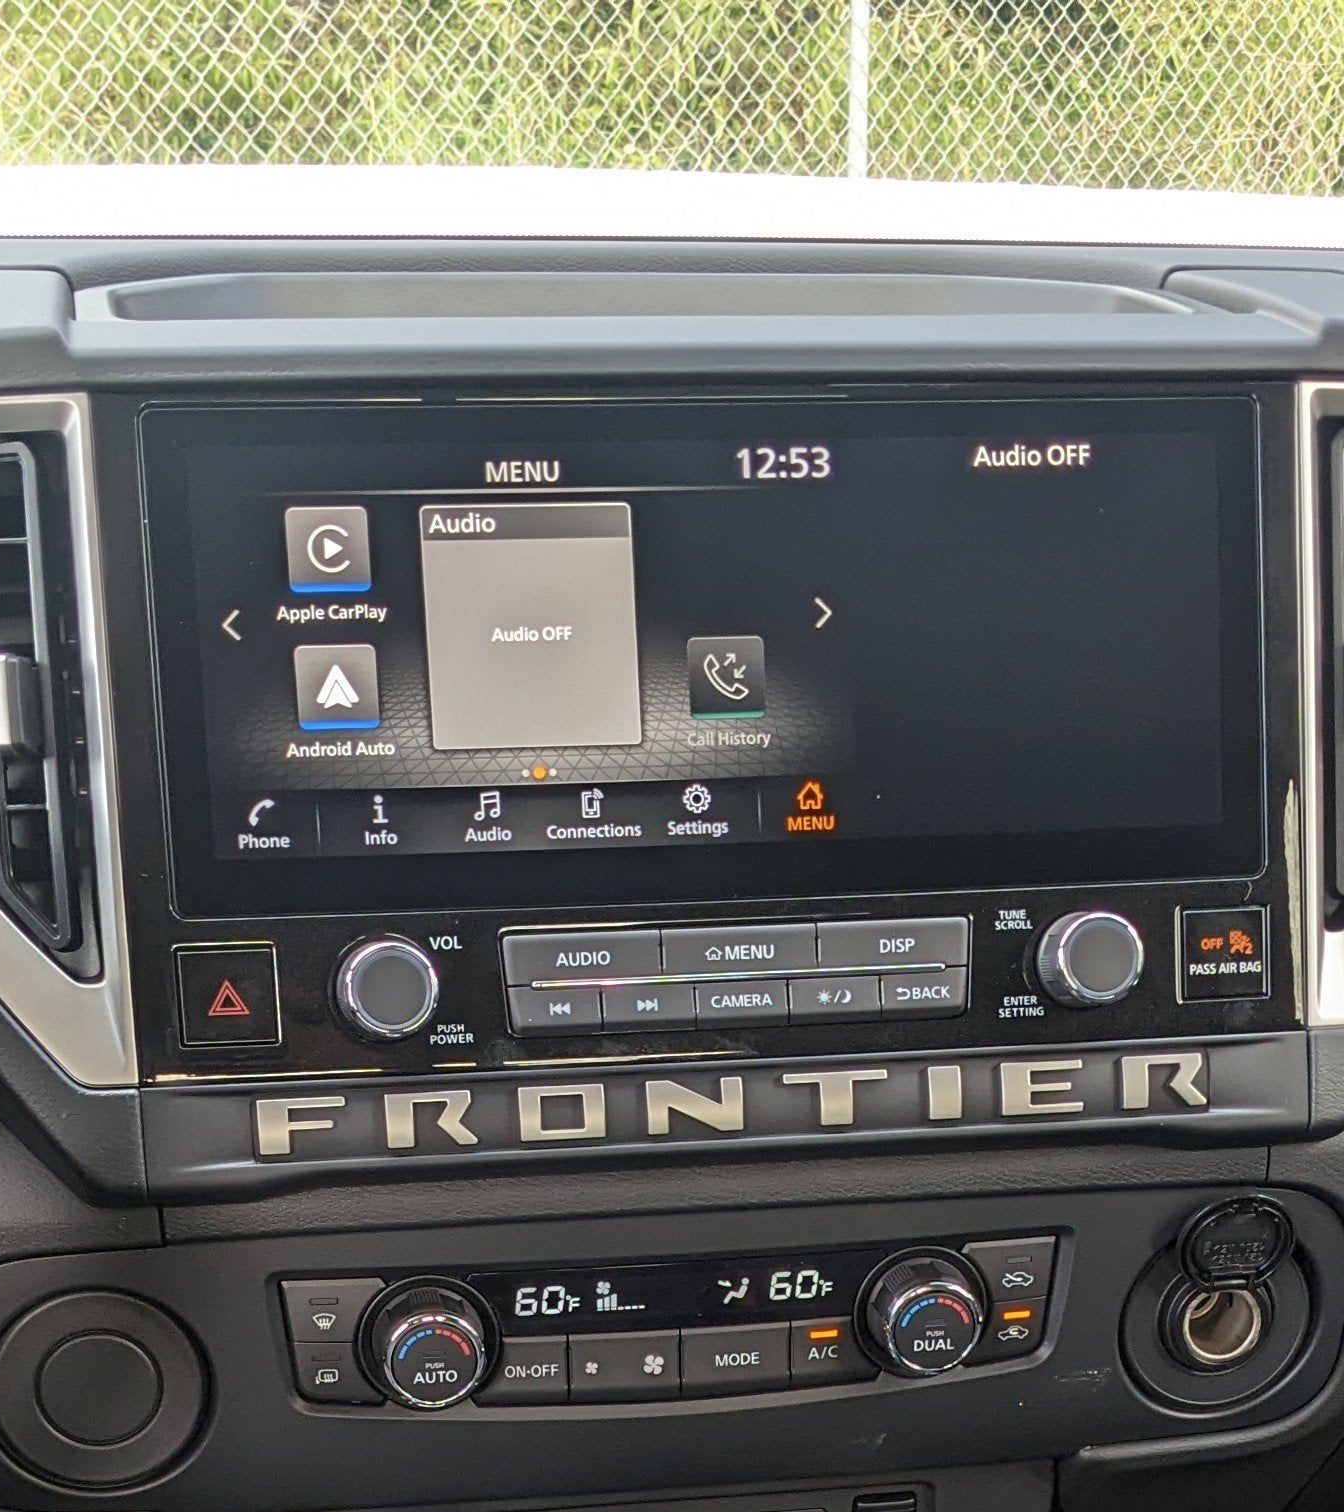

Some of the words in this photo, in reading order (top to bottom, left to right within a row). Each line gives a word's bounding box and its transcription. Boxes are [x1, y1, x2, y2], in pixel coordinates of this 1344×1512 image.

[736, 446, 831, 479] 12:53
[973, 445, 1042, 468] Audio
[1047, 444, 1091, 466] OFF
[485, 460, 560, 483] MENU
[429, 513, 496, 535] Audio
[276, 604, 325, 623] Apple
[328, 603, 387, 622] CarPlay
[491, 626, 540, 643] Audio
[543, 625, 573, 642] OFF
[687, 732, 715, 747] Call
[718, 731, 771, 750] History
[286, 741, 352, 758] Android
[356, 740, 395, 757] Auto
[546, 823, 642, 839] Connections
[667, 820, 729, 837] Settings
[787, 815, 835, 832] MENU
[238, 833, 290, 849] Phone
[365, 830, 398, 846] Info
[465, 826, 512, 842] Audio
[998, 909, 1027, 921] TUNE
[994, 919, 1033, 931] SCROLL
[429, 936, 463, 951] VOL
[879, 938, 916, 954] DISP
[1200, 936, 1224, 951] OFF
[556, 950, 611, 967] AUDIO
[725, 944, 775, 961] MENU
[1189, 963, 1216, 976] PASS
[1218, 962, 1238, 974] AIR
[1239, 961, 1262, 974] BAG
[913, 985, 951, 1000] BACK
[711, 994, 773, 1009] CAMERA
[1003, 995, 1038, 1007] ENTER
[998, 1006, 1044, 1018] SETTING
[437, 1024, 465, 1034] PUSH
[429, 1033, 475, 1046] POWER
[256, 1052, 1209, 1156] FRONTIER
[807, 1345, 839, 1361] A/C
[913, 1338, 956, 1354] DUAL
[715, 1351, 760, 1368] MODE
[413, 1369, 458, 1385] AUTO
